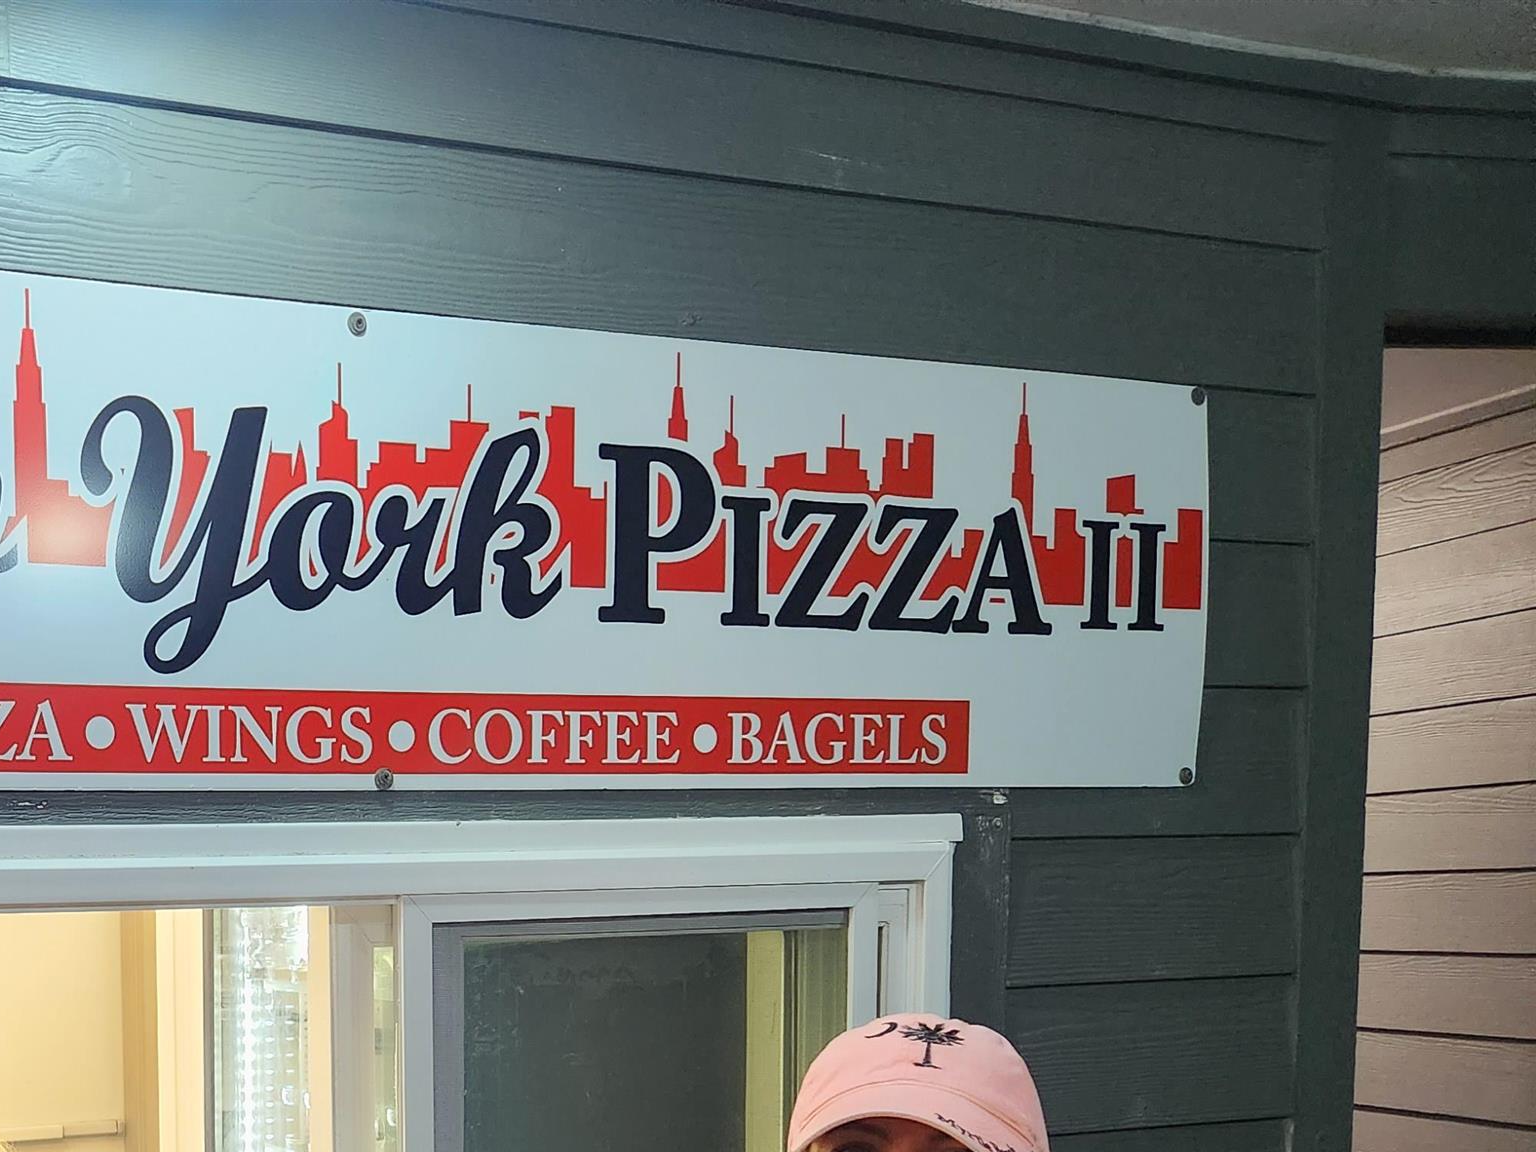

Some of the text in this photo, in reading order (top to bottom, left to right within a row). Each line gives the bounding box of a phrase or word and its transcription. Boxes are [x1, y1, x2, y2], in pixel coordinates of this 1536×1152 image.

[80, 394, 563, 674] York
[597, 442, 1053, 636] PIZZA
[1080, 519, 1167, 633] II
[124, 703, 374, 764] WINGS
[427, 707, 681, 765] COFFEE
[726, 710, 948, 765] BAGELS
